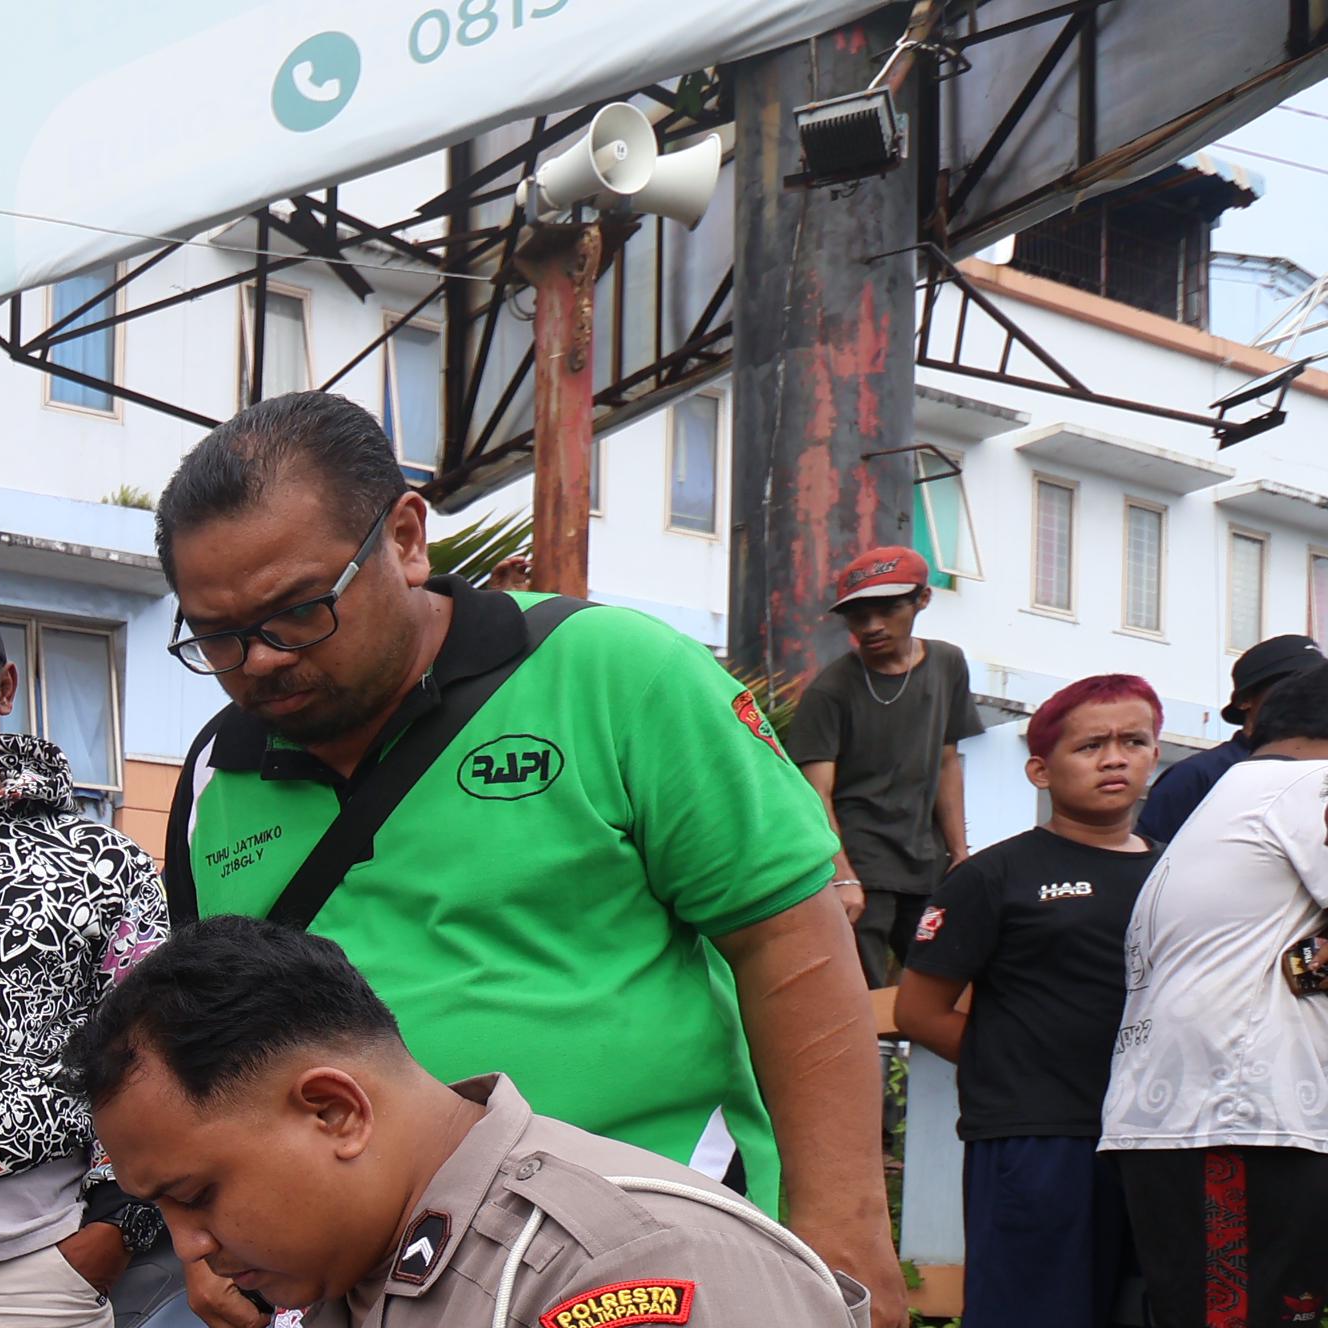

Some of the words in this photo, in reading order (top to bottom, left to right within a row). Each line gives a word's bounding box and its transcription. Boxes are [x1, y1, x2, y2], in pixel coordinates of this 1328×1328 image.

[472, 750, 550, 784] RAPI
[205, 846, 229, 866] TUHU
[233, 825, 282, 855] JATMIKO
[557, 1286, 677, 1328] POLRESTA
